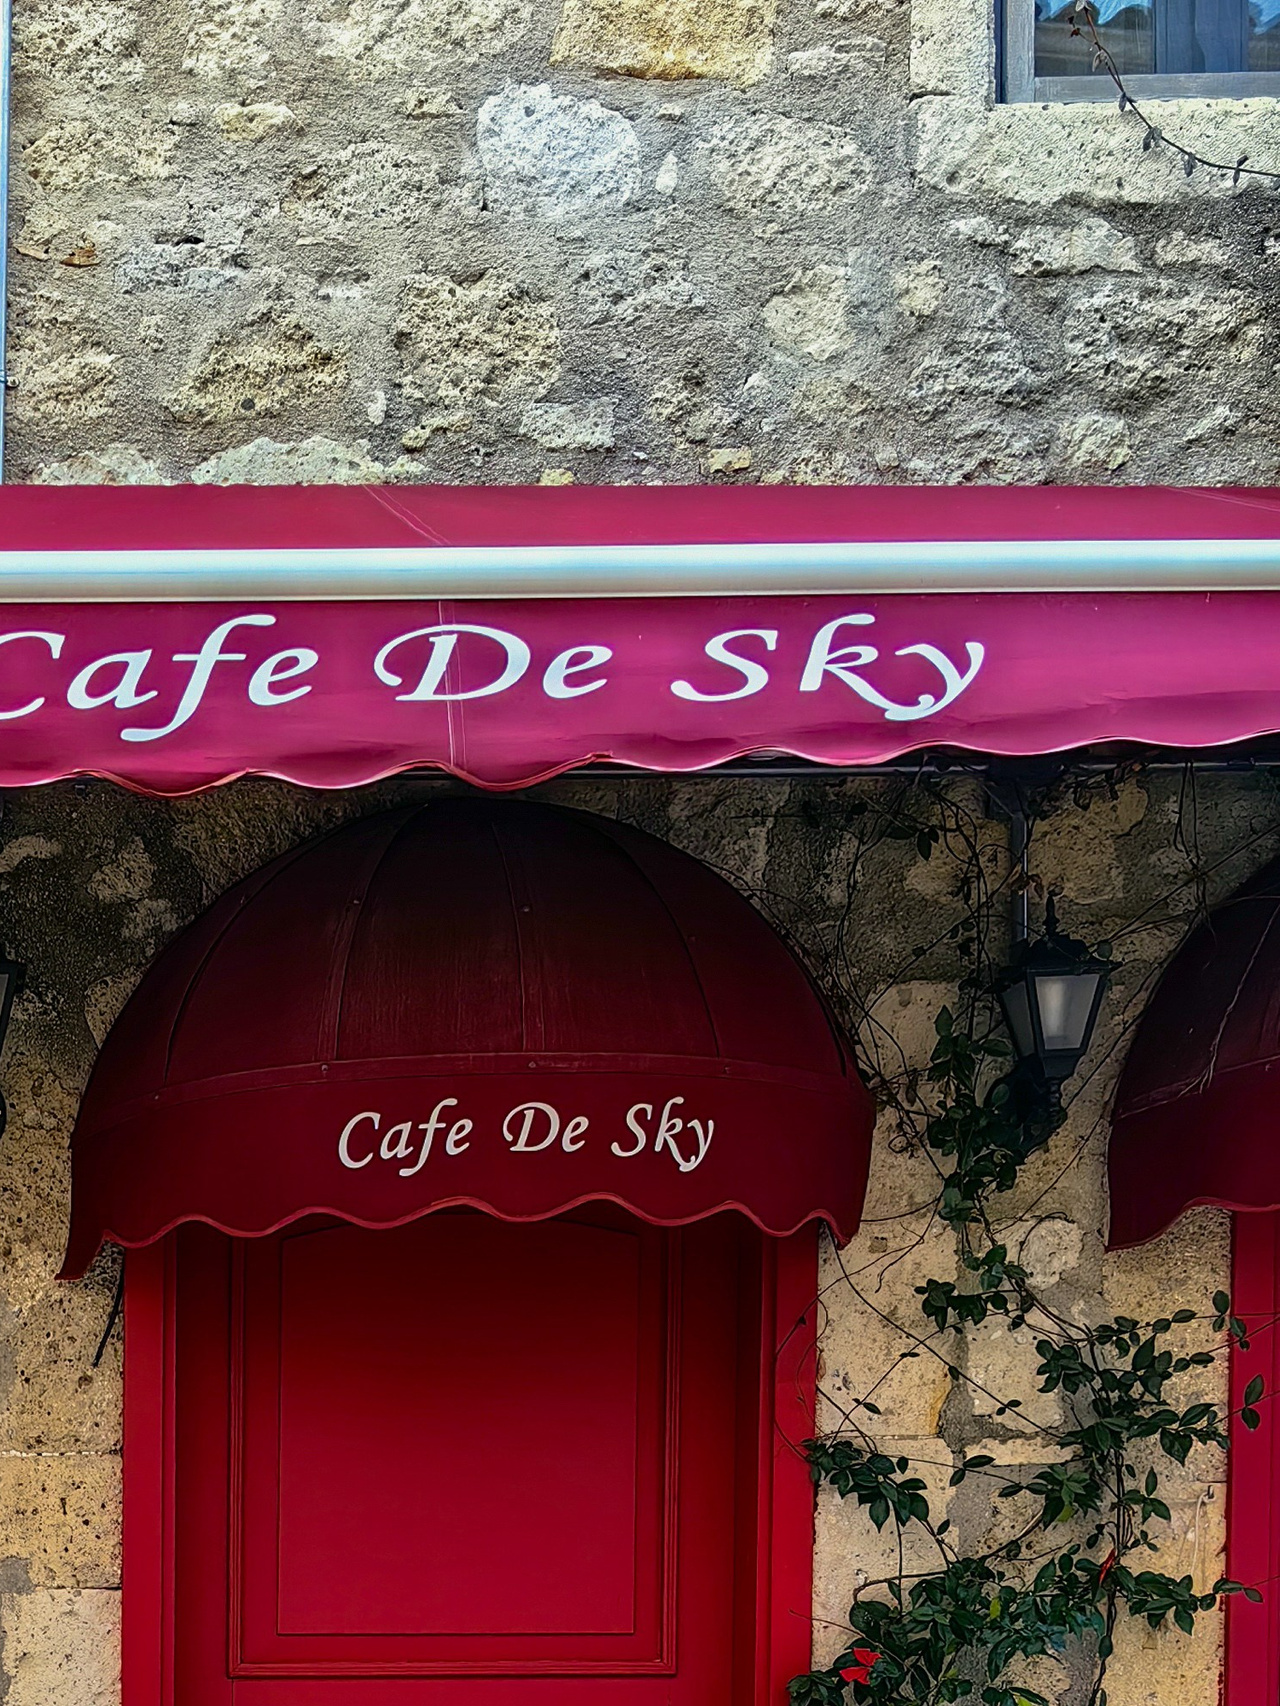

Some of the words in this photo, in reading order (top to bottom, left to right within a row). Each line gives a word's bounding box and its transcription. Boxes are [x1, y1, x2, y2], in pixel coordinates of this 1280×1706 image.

[372, 624, 613, 702] De
[669, 613, 985, 722] Sky
[338, 1097, 473, 1177] Cafe
[502, 1101, 589, 1153] De
[610, 1096, 715, 1173] Sky
